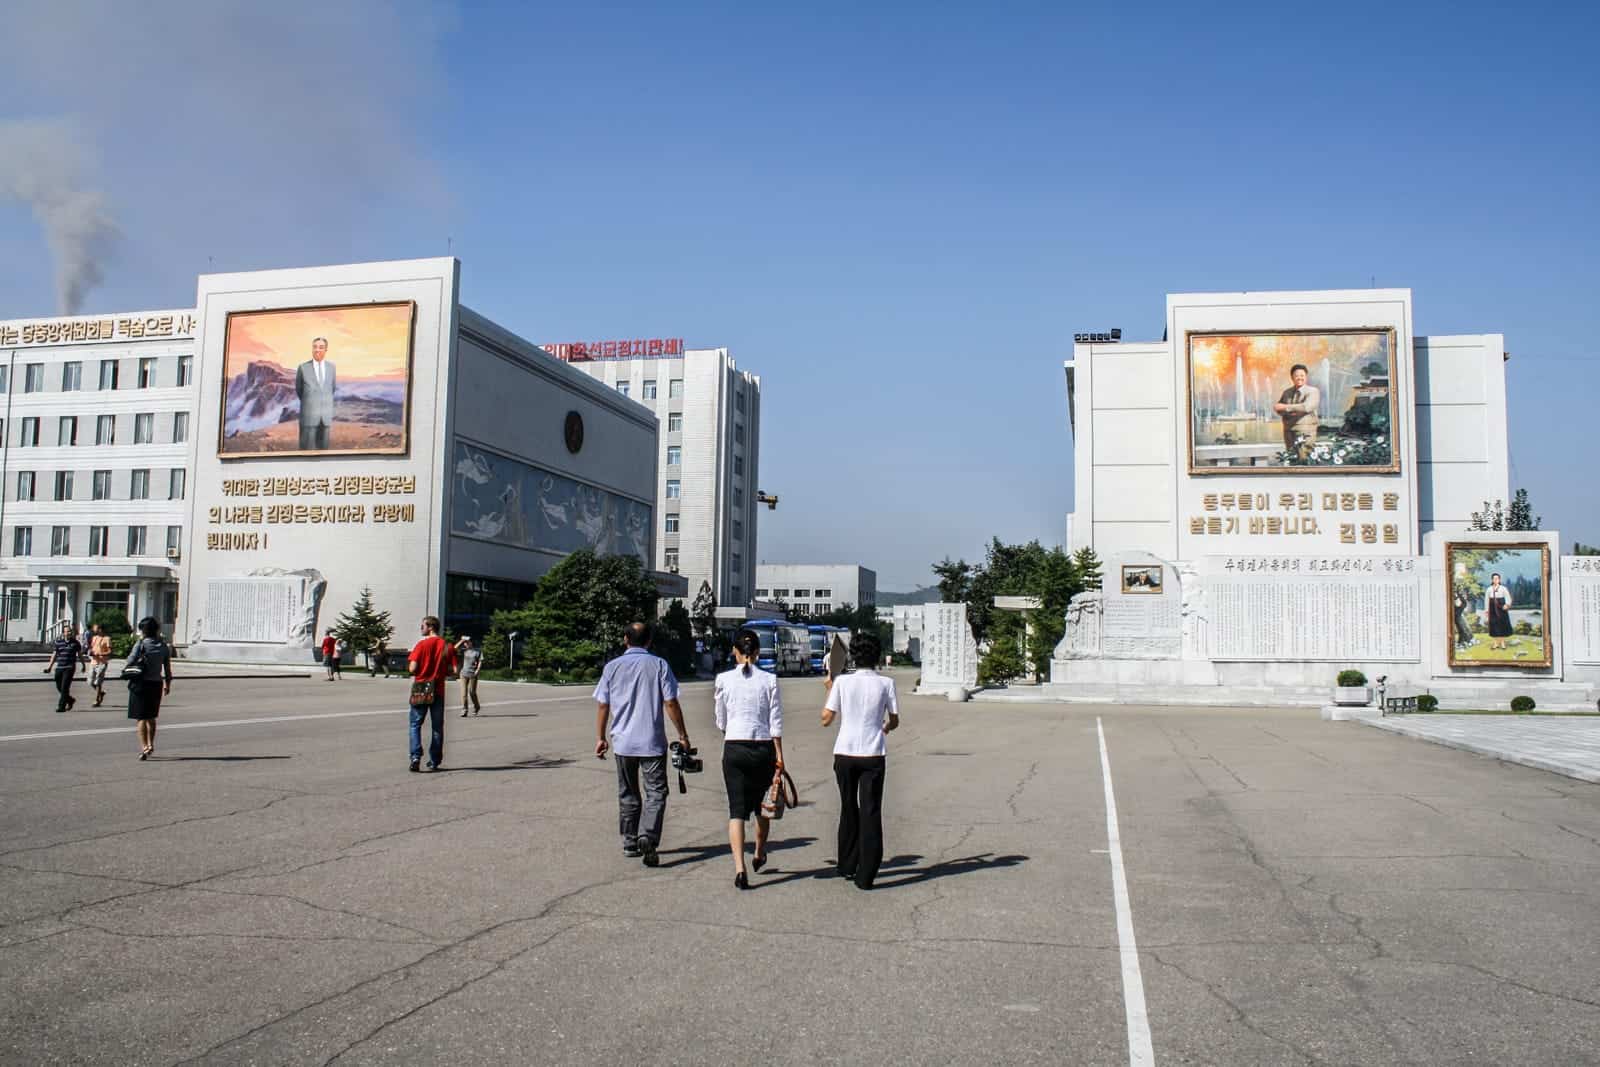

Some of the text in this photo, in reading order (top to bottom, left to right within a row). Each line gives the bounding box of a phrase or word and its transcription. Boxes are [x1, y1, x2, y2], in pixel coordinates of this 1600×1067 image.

[23, 320, 115, 343] 당중앙위원회를
[119, 315, 174, 337] 목숨으로
[178, 314, 196, 335] 사
[222, 479, 260, 496] 위대한
[1203, 493, 1400, 511] 동무들이 우리 대장을 잘
[208, 505, 222, 525] 의
[225, 504, 265, 525] 나라를
[373, 503, 415, 523] 만방에
[1190, 516, 1322, 535] 받들기 바랍니다.
